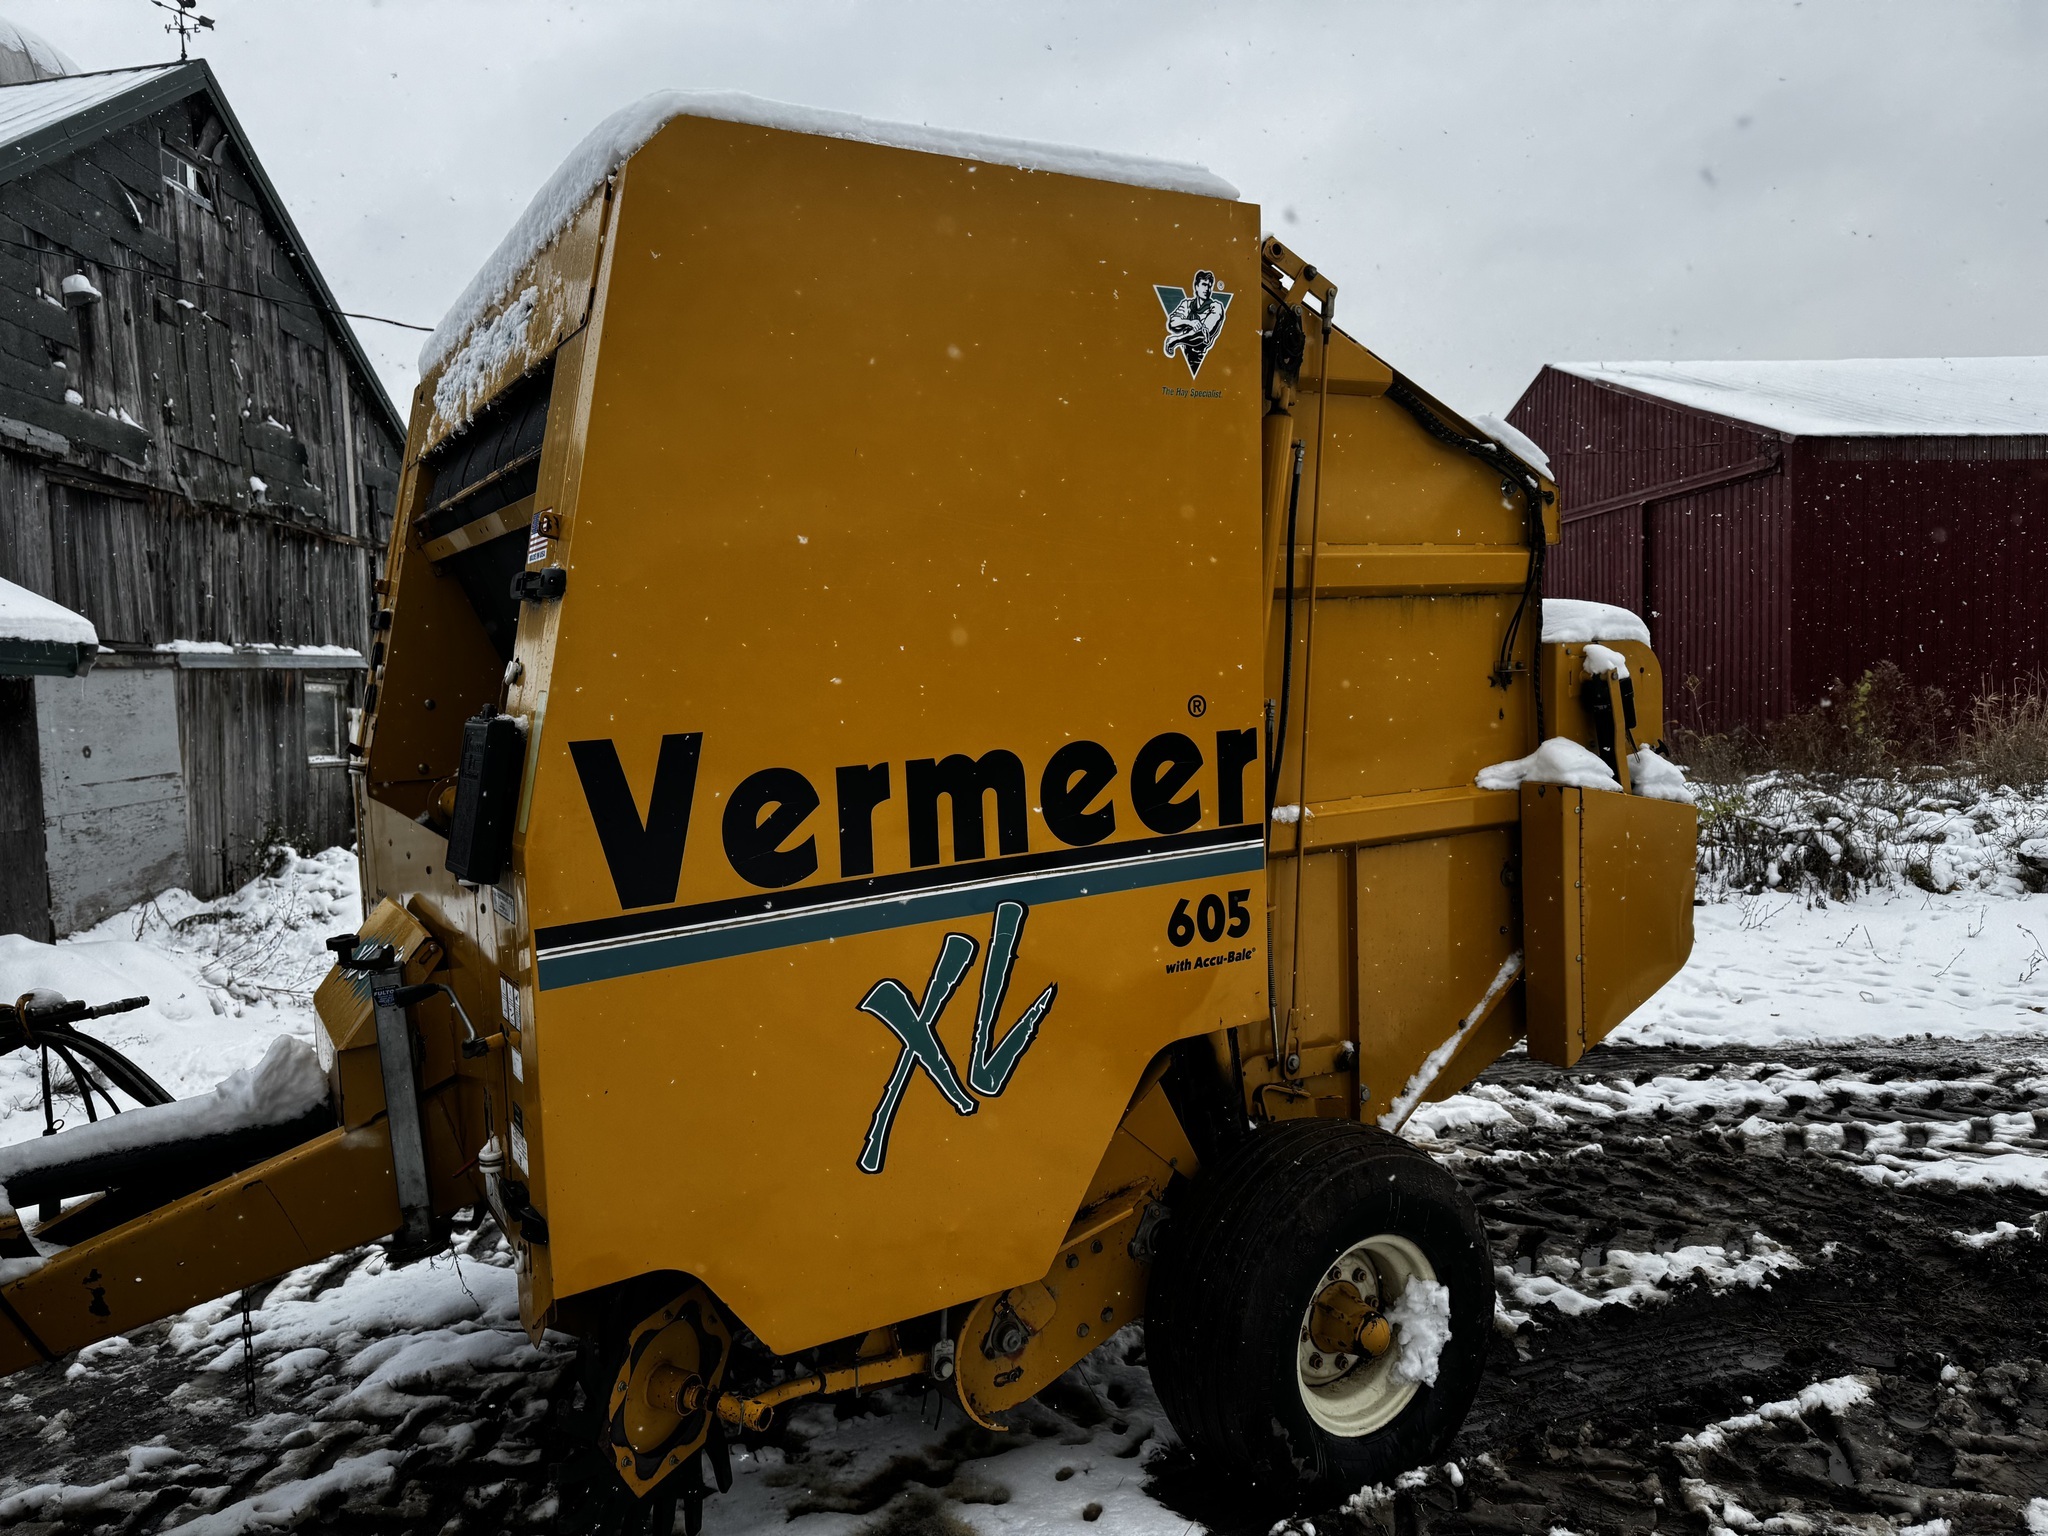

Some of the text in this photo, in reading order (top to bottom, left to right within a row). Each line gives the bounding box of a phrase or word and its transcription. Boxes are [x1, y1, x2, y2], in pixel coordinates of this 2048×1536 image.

[1162, 386, 1222, 399] The Hay Specialist
[568, 727, 1258, 910] Vermeer
[1167, 888, 1251, 948] 605
[1165, 958, 1192, 975] with
[373, 988, 395, 996] FULTO
[856, 899, 1058, 1174] XL
